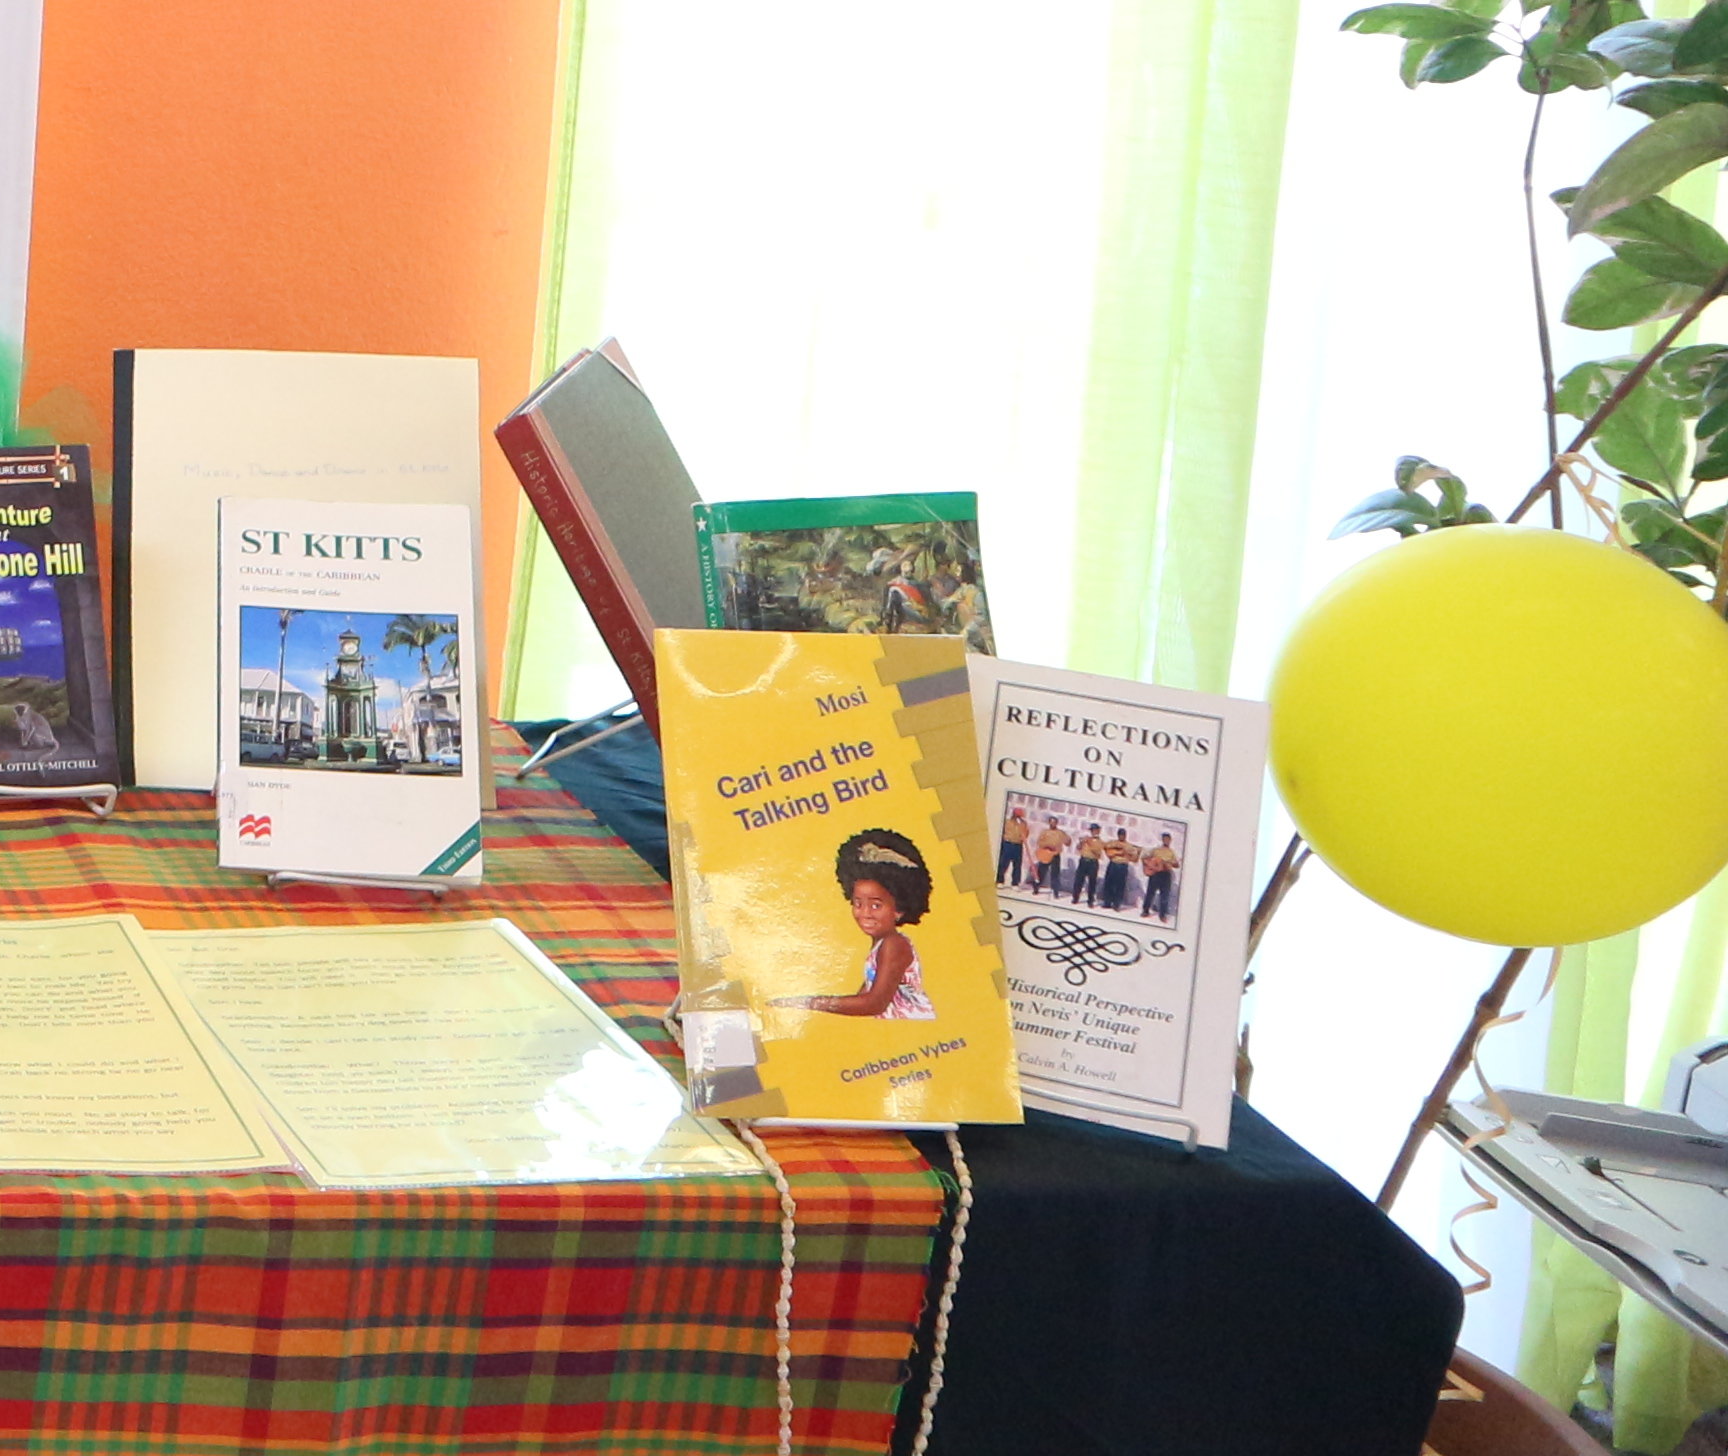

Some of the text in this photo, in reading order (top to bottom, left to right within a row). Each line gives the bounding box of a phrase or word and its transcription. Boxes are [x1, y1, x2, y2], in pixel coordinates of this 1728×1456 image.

[18, 464, 46, 474] SERIES
[60, 467, 69, 481] 1
[44, 543, 84, 576] Hill
[241, 528, 423, 562] ST KITTS
[239, 566, 282, 575] CRADLE
[317, 570, 381, 581] CARIBBEAN
[815, 686, 869, 716] Mosi
[1006, 705, 1210, 755] REFLECTIONS
[7, 760, 98, 772] OTTLEY-MITCHELL
[717, 741, 874, 799] Cari and the
[1084, 746, 1124, 767] ON
[997, 758, 1206, 811] CULTURAMA
[734, 769, 889, 831] Talking Bird
[1082, 1012, 1140, 1035] Unique
[1085, 994, 1174, 1023] Perspective
[1012, 1017, 1137, 1054] ummer Festival
[839, 1035, 966, 1085] Caribbean Vybes
[888, 1067, 932, 1089] Series
